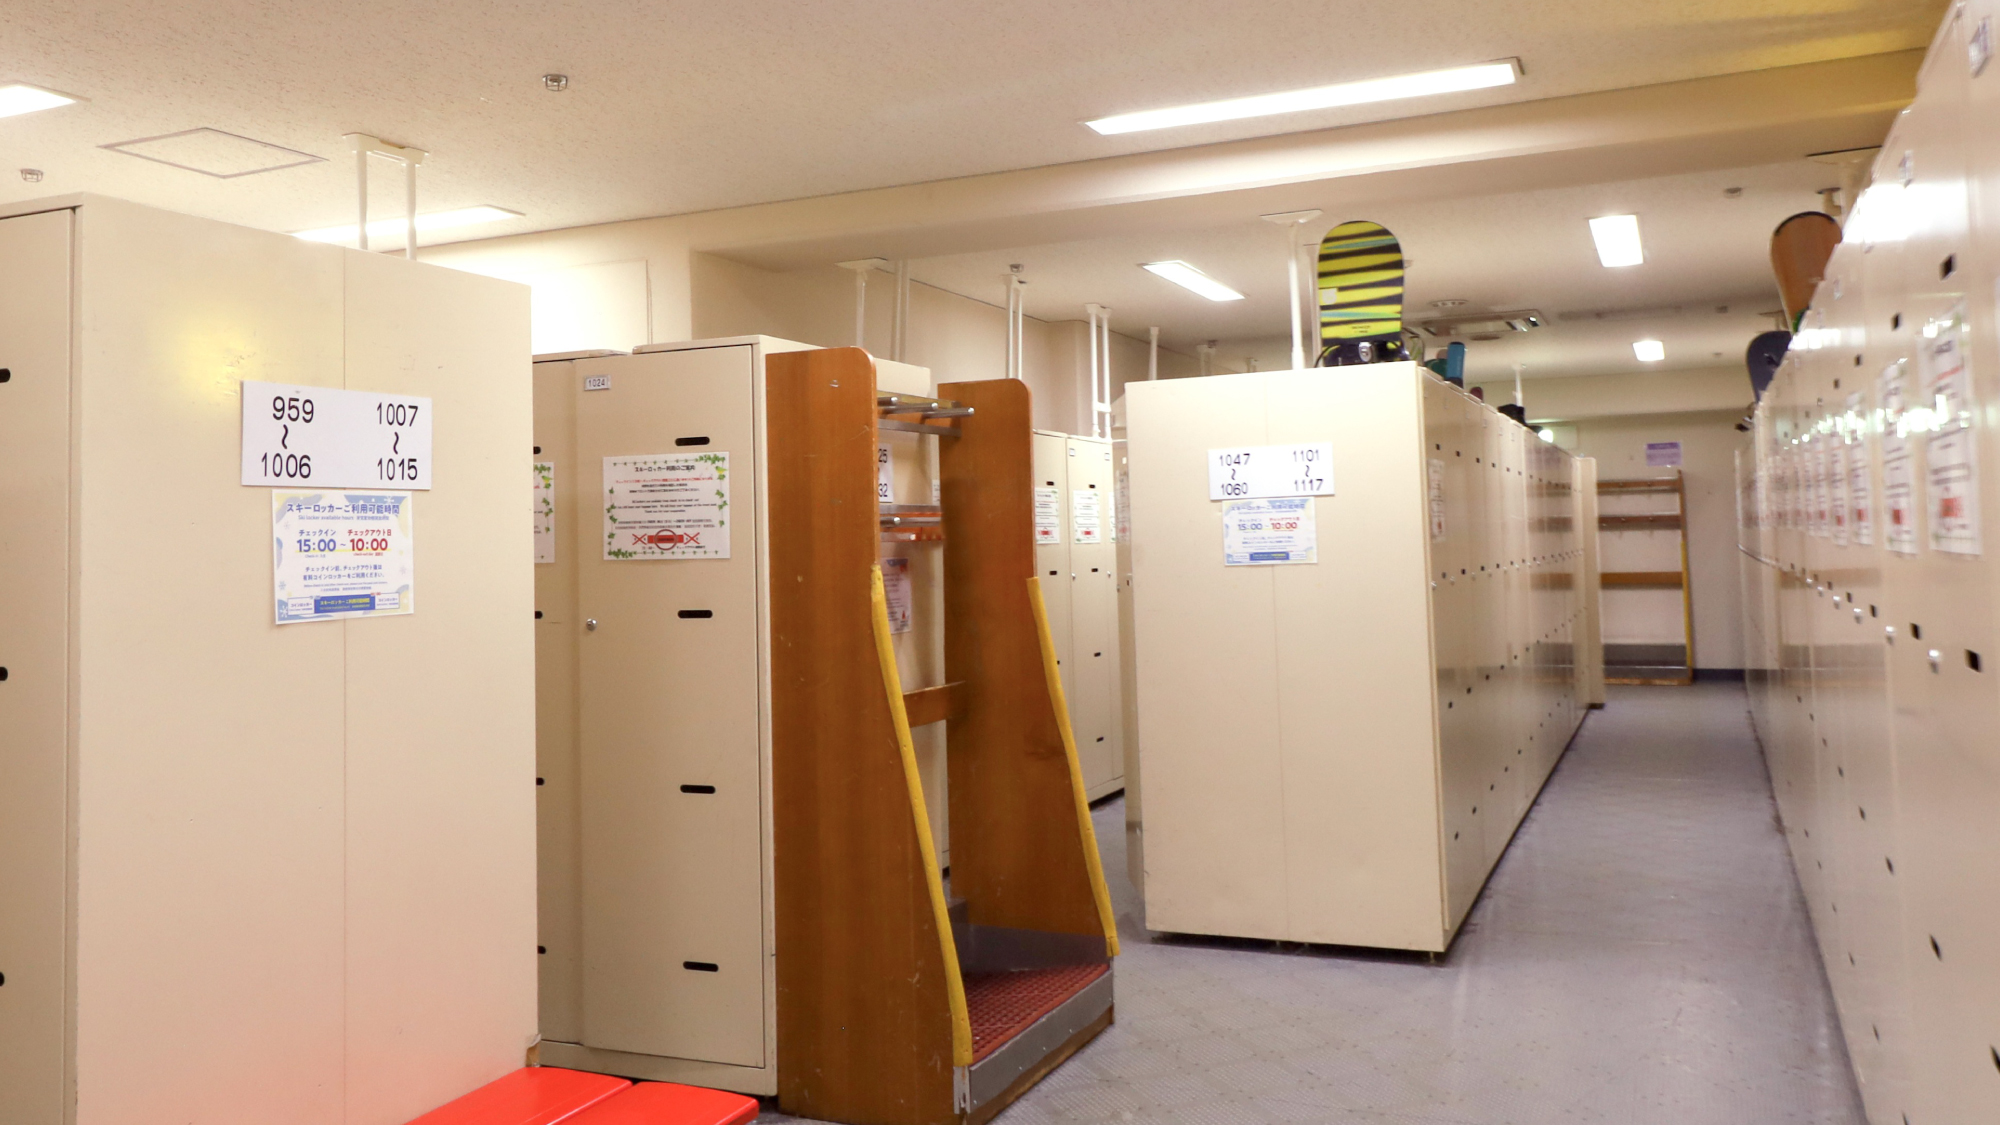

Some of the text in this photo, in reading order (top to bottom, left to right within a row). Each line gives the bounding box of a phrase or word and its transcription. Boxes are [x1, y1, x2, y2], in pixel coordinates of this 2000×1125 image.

[588, 378, 605, 387] 1024
[272, 396, 314, 423] 959
[376, 402, 418, 427] 1007
[878, 448, 888, 463] 25
[1219, 453, 1250, 466] 1047
[1293, 449, 1320, 462] 1101
[261, 452, 311, 478] 1006
[377, 458, 418, 481] 1015
[878, 483, 888, 498] 32
[1221, 482, 1248, 496] 1060
[1294, 479, 1323, 492] 1117
[287, 503, 400, 514] スキーロッカーご利用可能時間
[348, 528, 392, 536] チェックアウト日
[297, 538, 336, 553] 15:00
[350, 538, 388, 552] 10:00
